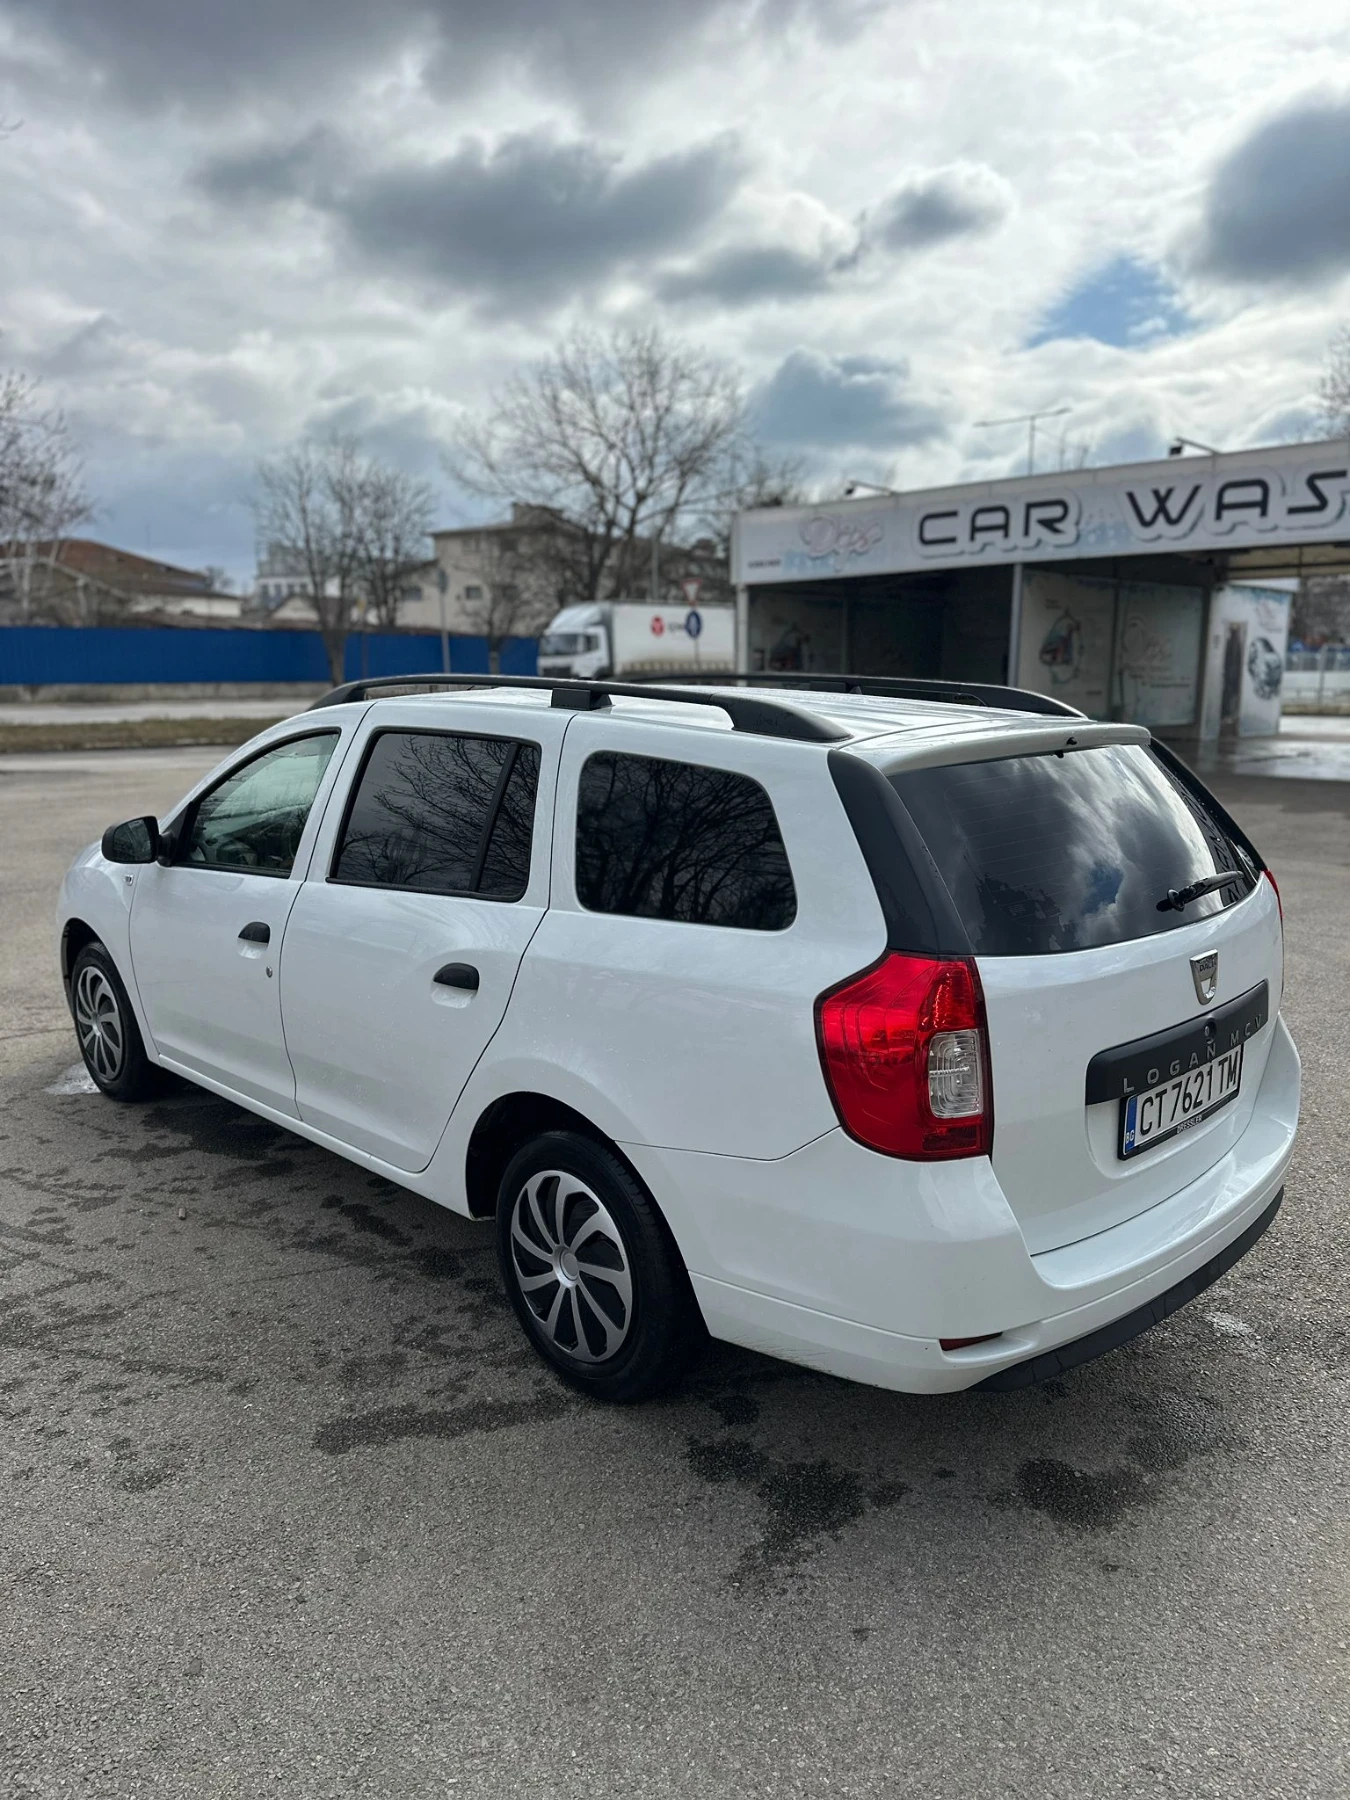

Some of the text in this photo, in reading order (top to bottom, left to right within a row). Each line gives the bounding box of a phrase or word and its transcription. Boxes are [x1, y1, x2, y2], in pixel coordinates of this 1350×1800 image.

[919, 499, 1069, 546] CAR
[1123, 1014, 1262, 1093] LOGAN MCV
[1125, 1130, 1135, 1144] BG
